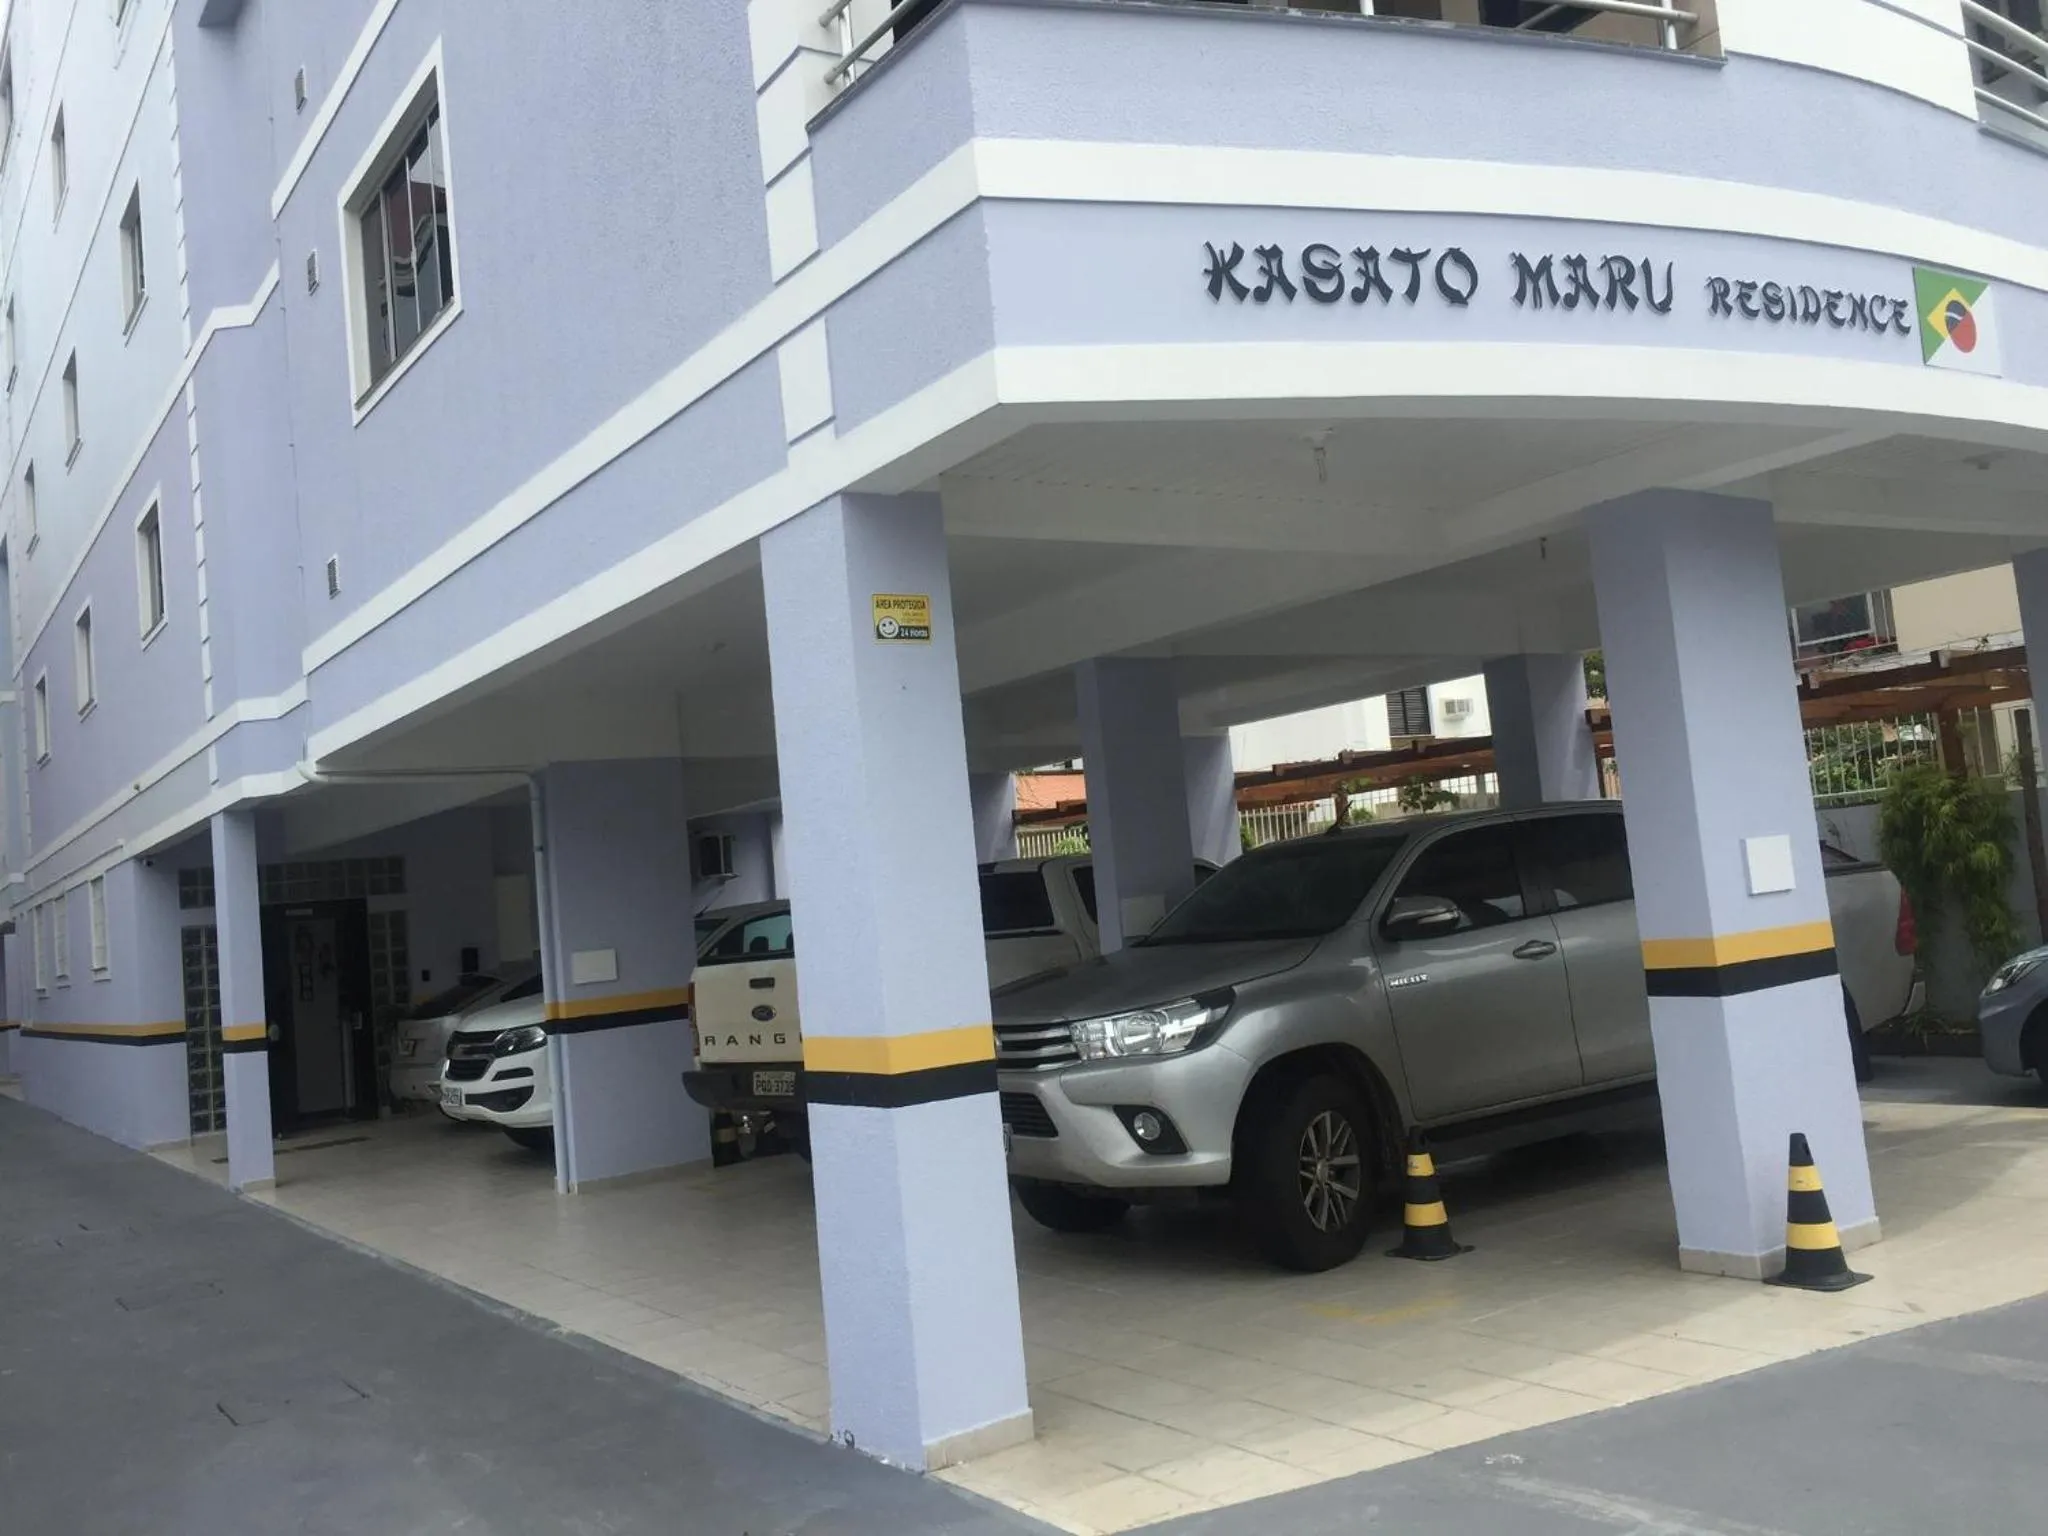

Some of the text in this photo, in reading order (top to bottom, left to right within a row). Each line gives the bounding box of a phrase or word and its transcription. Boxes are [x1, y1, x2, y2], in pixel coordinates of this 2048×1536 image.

[1202, 241, 1912, 335] KASATO MARU RESIDENCE
[892, 599, 927, 611] PROTEGIDA
[900, 627, 909, 637] 24
